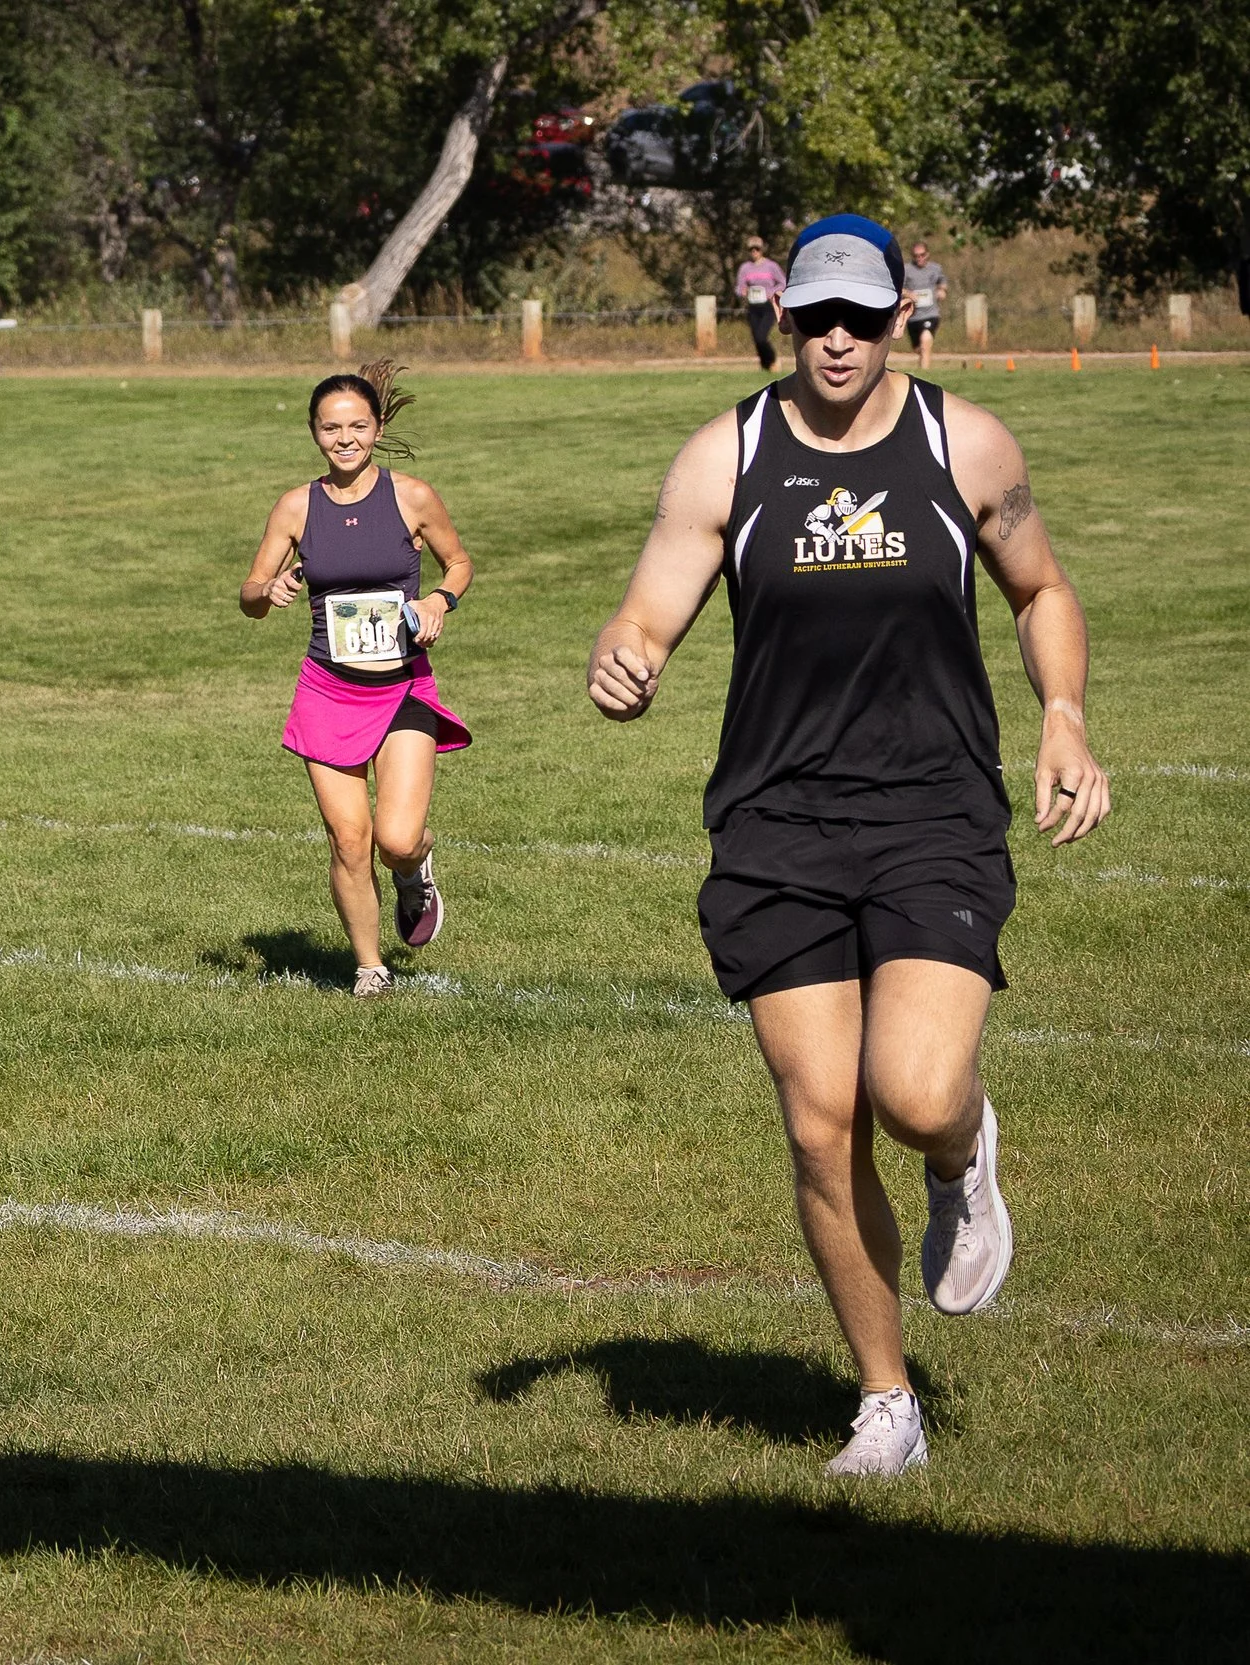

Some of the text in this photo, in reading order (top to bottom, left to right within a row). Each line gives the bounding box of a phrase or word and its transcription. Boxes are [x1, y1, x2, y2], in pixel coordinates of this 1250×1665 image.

[794, 531, 906, 563] LUTES
[793, 559, 908, 573] PACIFIC LUTHERAN UNIVERSITY
[345, 620, 391, 654] 690
